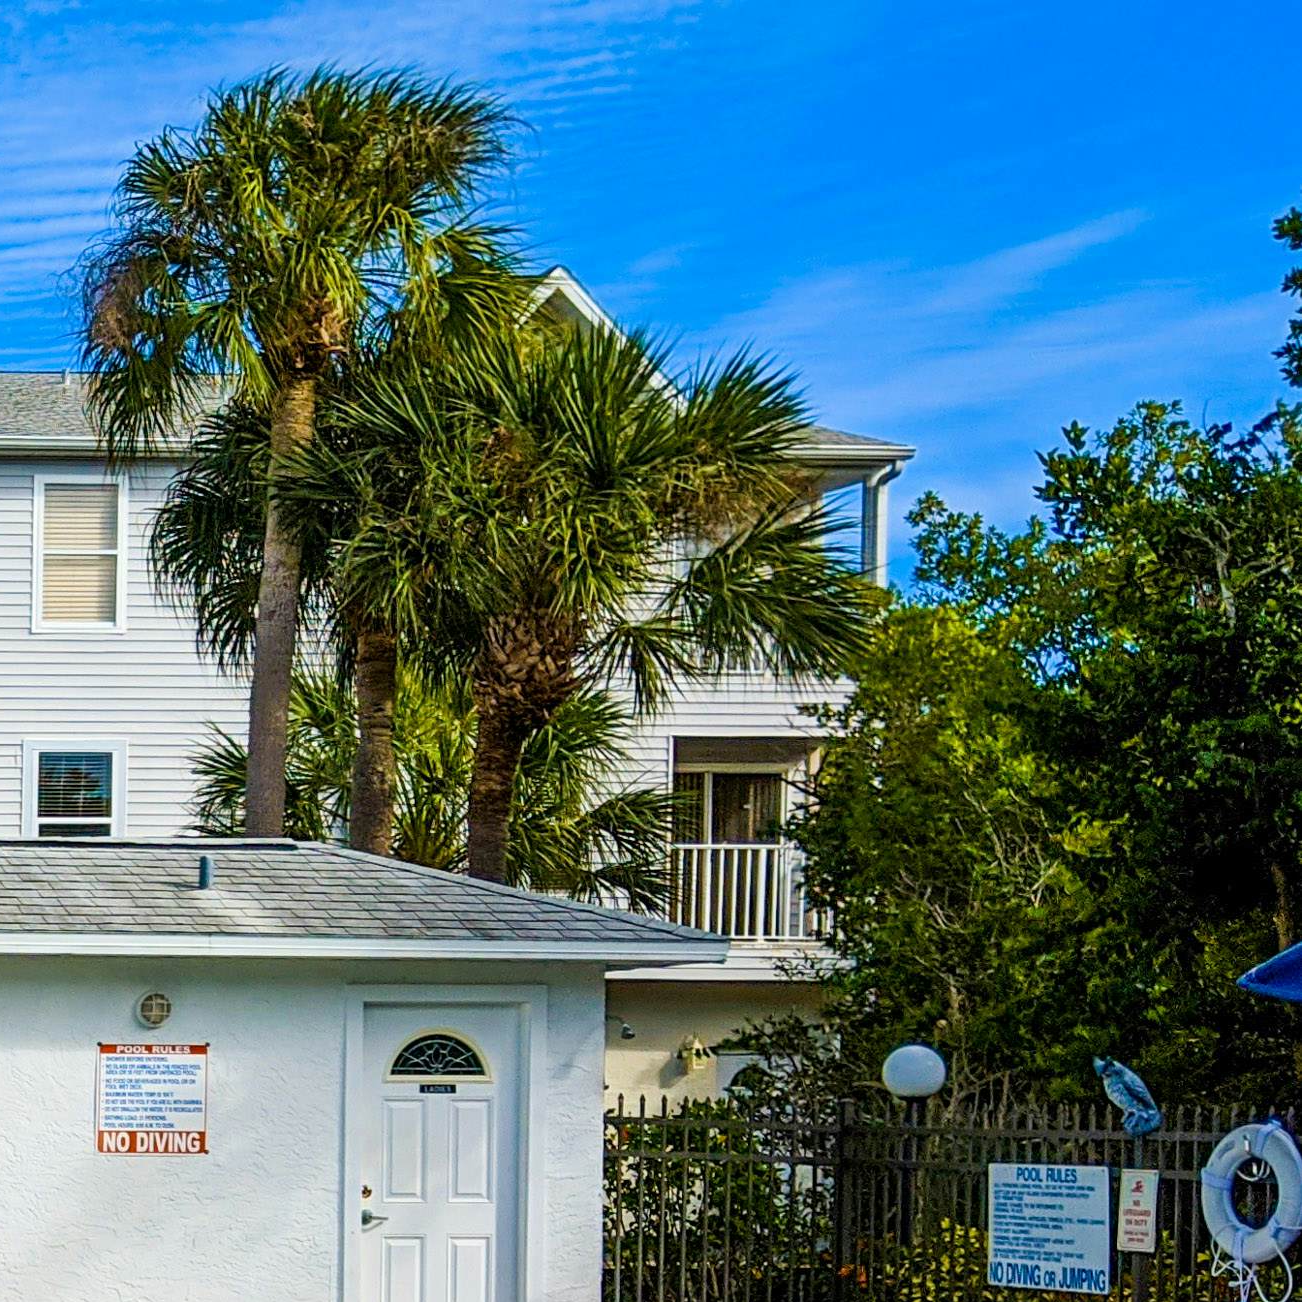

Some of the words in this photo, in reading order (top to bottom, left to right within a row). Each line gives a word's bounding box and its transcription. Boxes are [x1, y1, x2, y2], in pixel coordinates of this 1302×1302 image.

[103, 1132, 131, 1152] NO
[136, 1132, 200, 1152] DIVING
[1016, 1168, 1043, 1182] POOL
[1046, 1168, 1078, 1184] RULES
[990, 1263, 1004, 1283] NO
[1006, 1264, 1040, 1286] DIVING
[1044, 1271, 1056, 1288] OR
[1059, 1267, 1106, 1292] JUMPING
